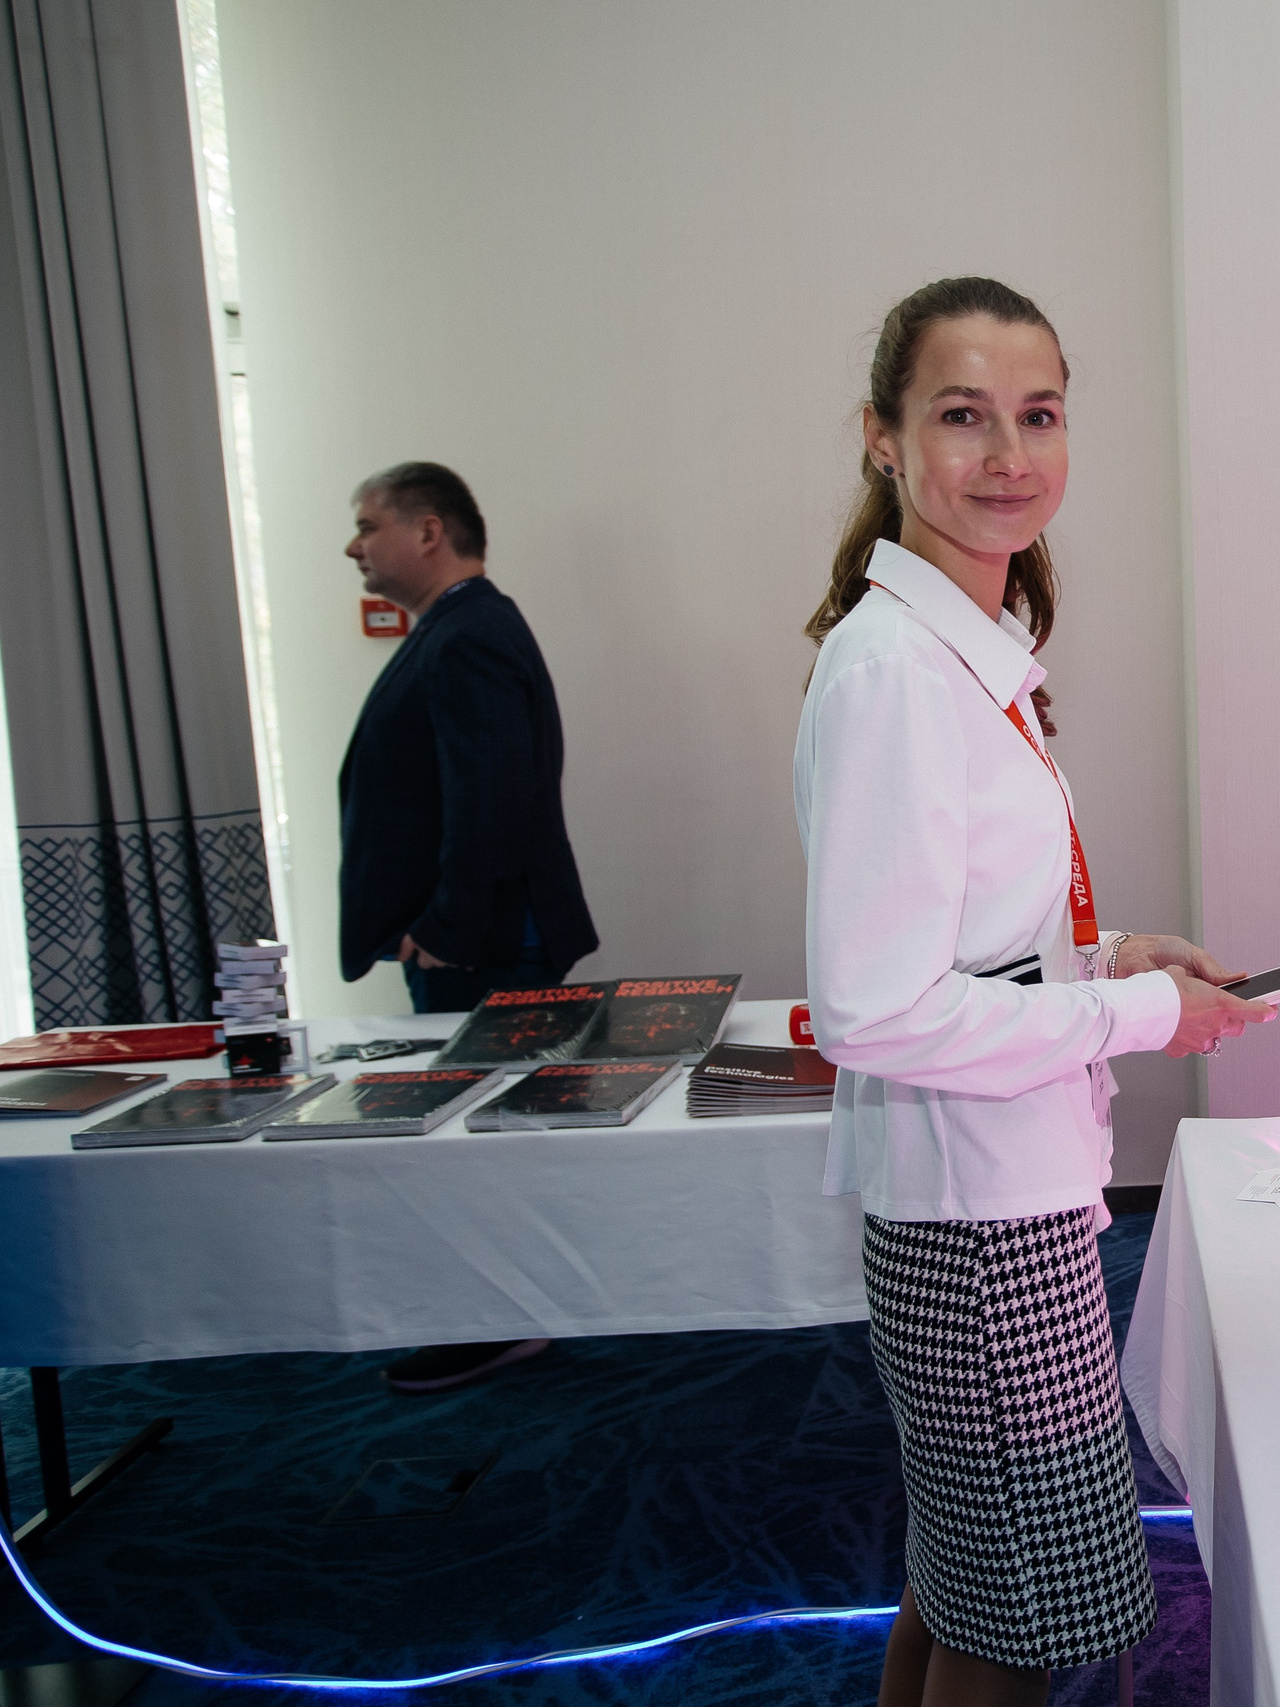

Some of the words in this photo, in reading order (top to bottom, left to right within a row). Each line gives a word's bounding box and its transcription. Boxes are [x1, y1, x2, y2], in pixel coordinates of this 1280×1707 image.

[614, 985, 734, 998] RESEARCH
[619, 979, 720, 992] POSITIVE
[485, 991, 605, 1007] RESEARCH
[490, 986, 592, 1001] POSITIVE
[703, 1069, 794, 1081] technologies
[704, 1066, 762, 1076] positive
